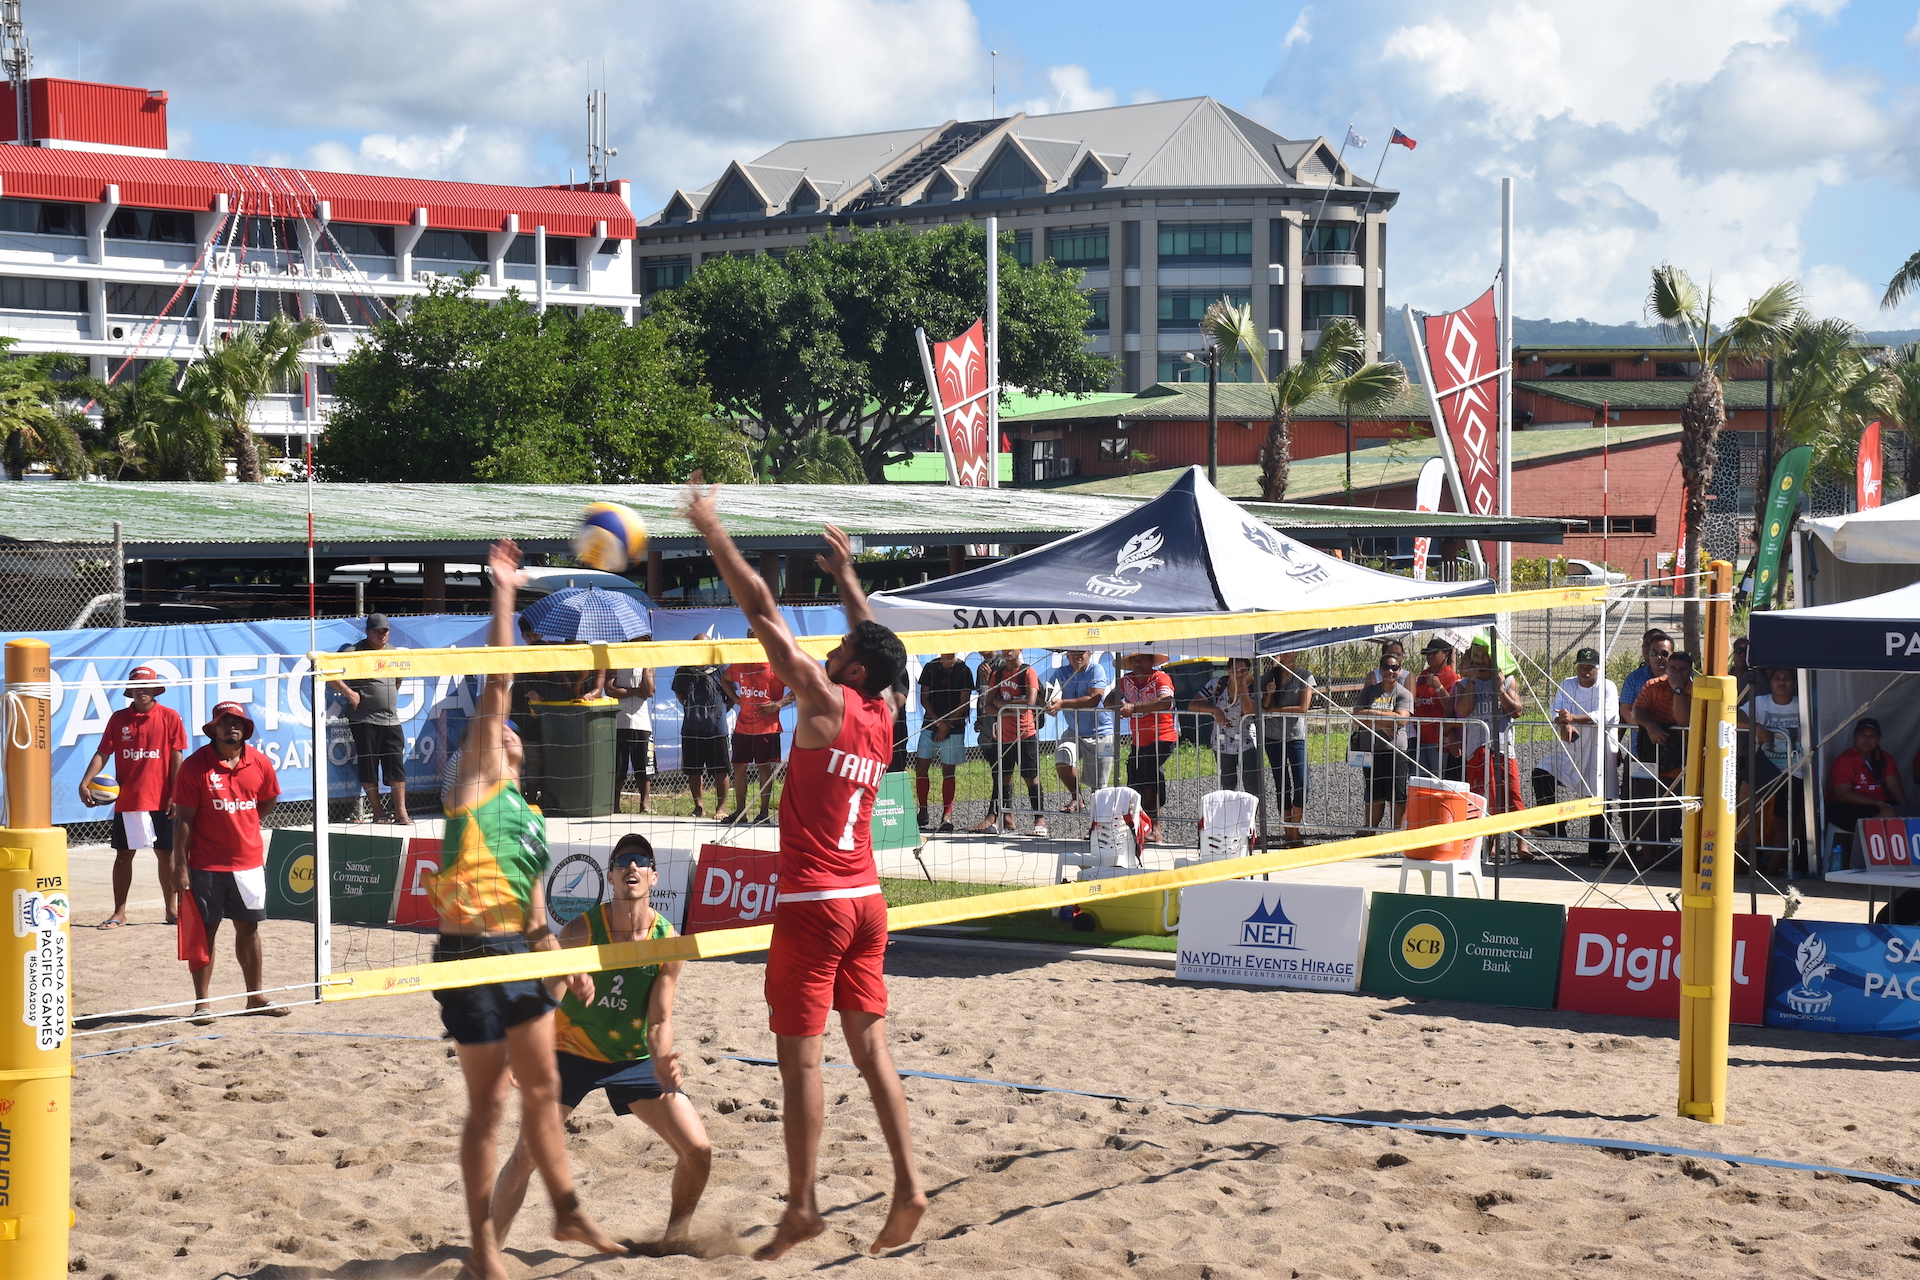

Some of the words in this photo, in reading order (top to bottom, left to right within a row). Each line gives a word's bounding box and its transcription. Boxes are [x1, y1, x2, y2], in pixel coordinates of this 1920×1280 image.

[1373, 621, 1413, 633] #SAMOA2019
[1414, 695, 1435, 707] gicel
[123, 748, 160, 761] Digicel
[212, 798, 258, 814] Digicel
[875, 797, 895, 806] Samoa
[838, 787, 866, 850] 1
[872, 805, 905, 816] Commercial
[881, 817, 898, 826] Bank
[1870, 833, 1886, 861] 0
[1890, 833, 1907, 861] 0
[345, 861, 372, 873] Samoa
[333, 871, 381, 884] Commercial
[343, 884, 364, 895] Bank
[702, 867, 780, 921] Digi
[1243, 924, 1294, 946] NEH
[1481, 931, 1519, 945] Samoa
[1405, 938, 1440, 955] SCB
[1464, 943, 1533, 960] Commercial
[41, 929, 53, 988] PACIFIC
[56, 937, 64, 991] SAMOA
[1481, 958, 1512, 974] Bank
[1575, 933, 1749, 991] Digil
[1182, 966, 1204, 974] YOUR
[1205, 967, 1242, 977] PREMIER
[1243, 970, 1276, 978] EVENTS
[1277, 972, 1309, 981] HIRAGE
[1311, 974, 1351, 984] COMPANY
[28, 956, 37, 1021] #SAMOA2019
[610, 975, 625, 995] 2
[597, 995, 629, 1011] AUS
[41, 992, 53, 1046] GAMES
[54, 995, 64, 1036] 2019
